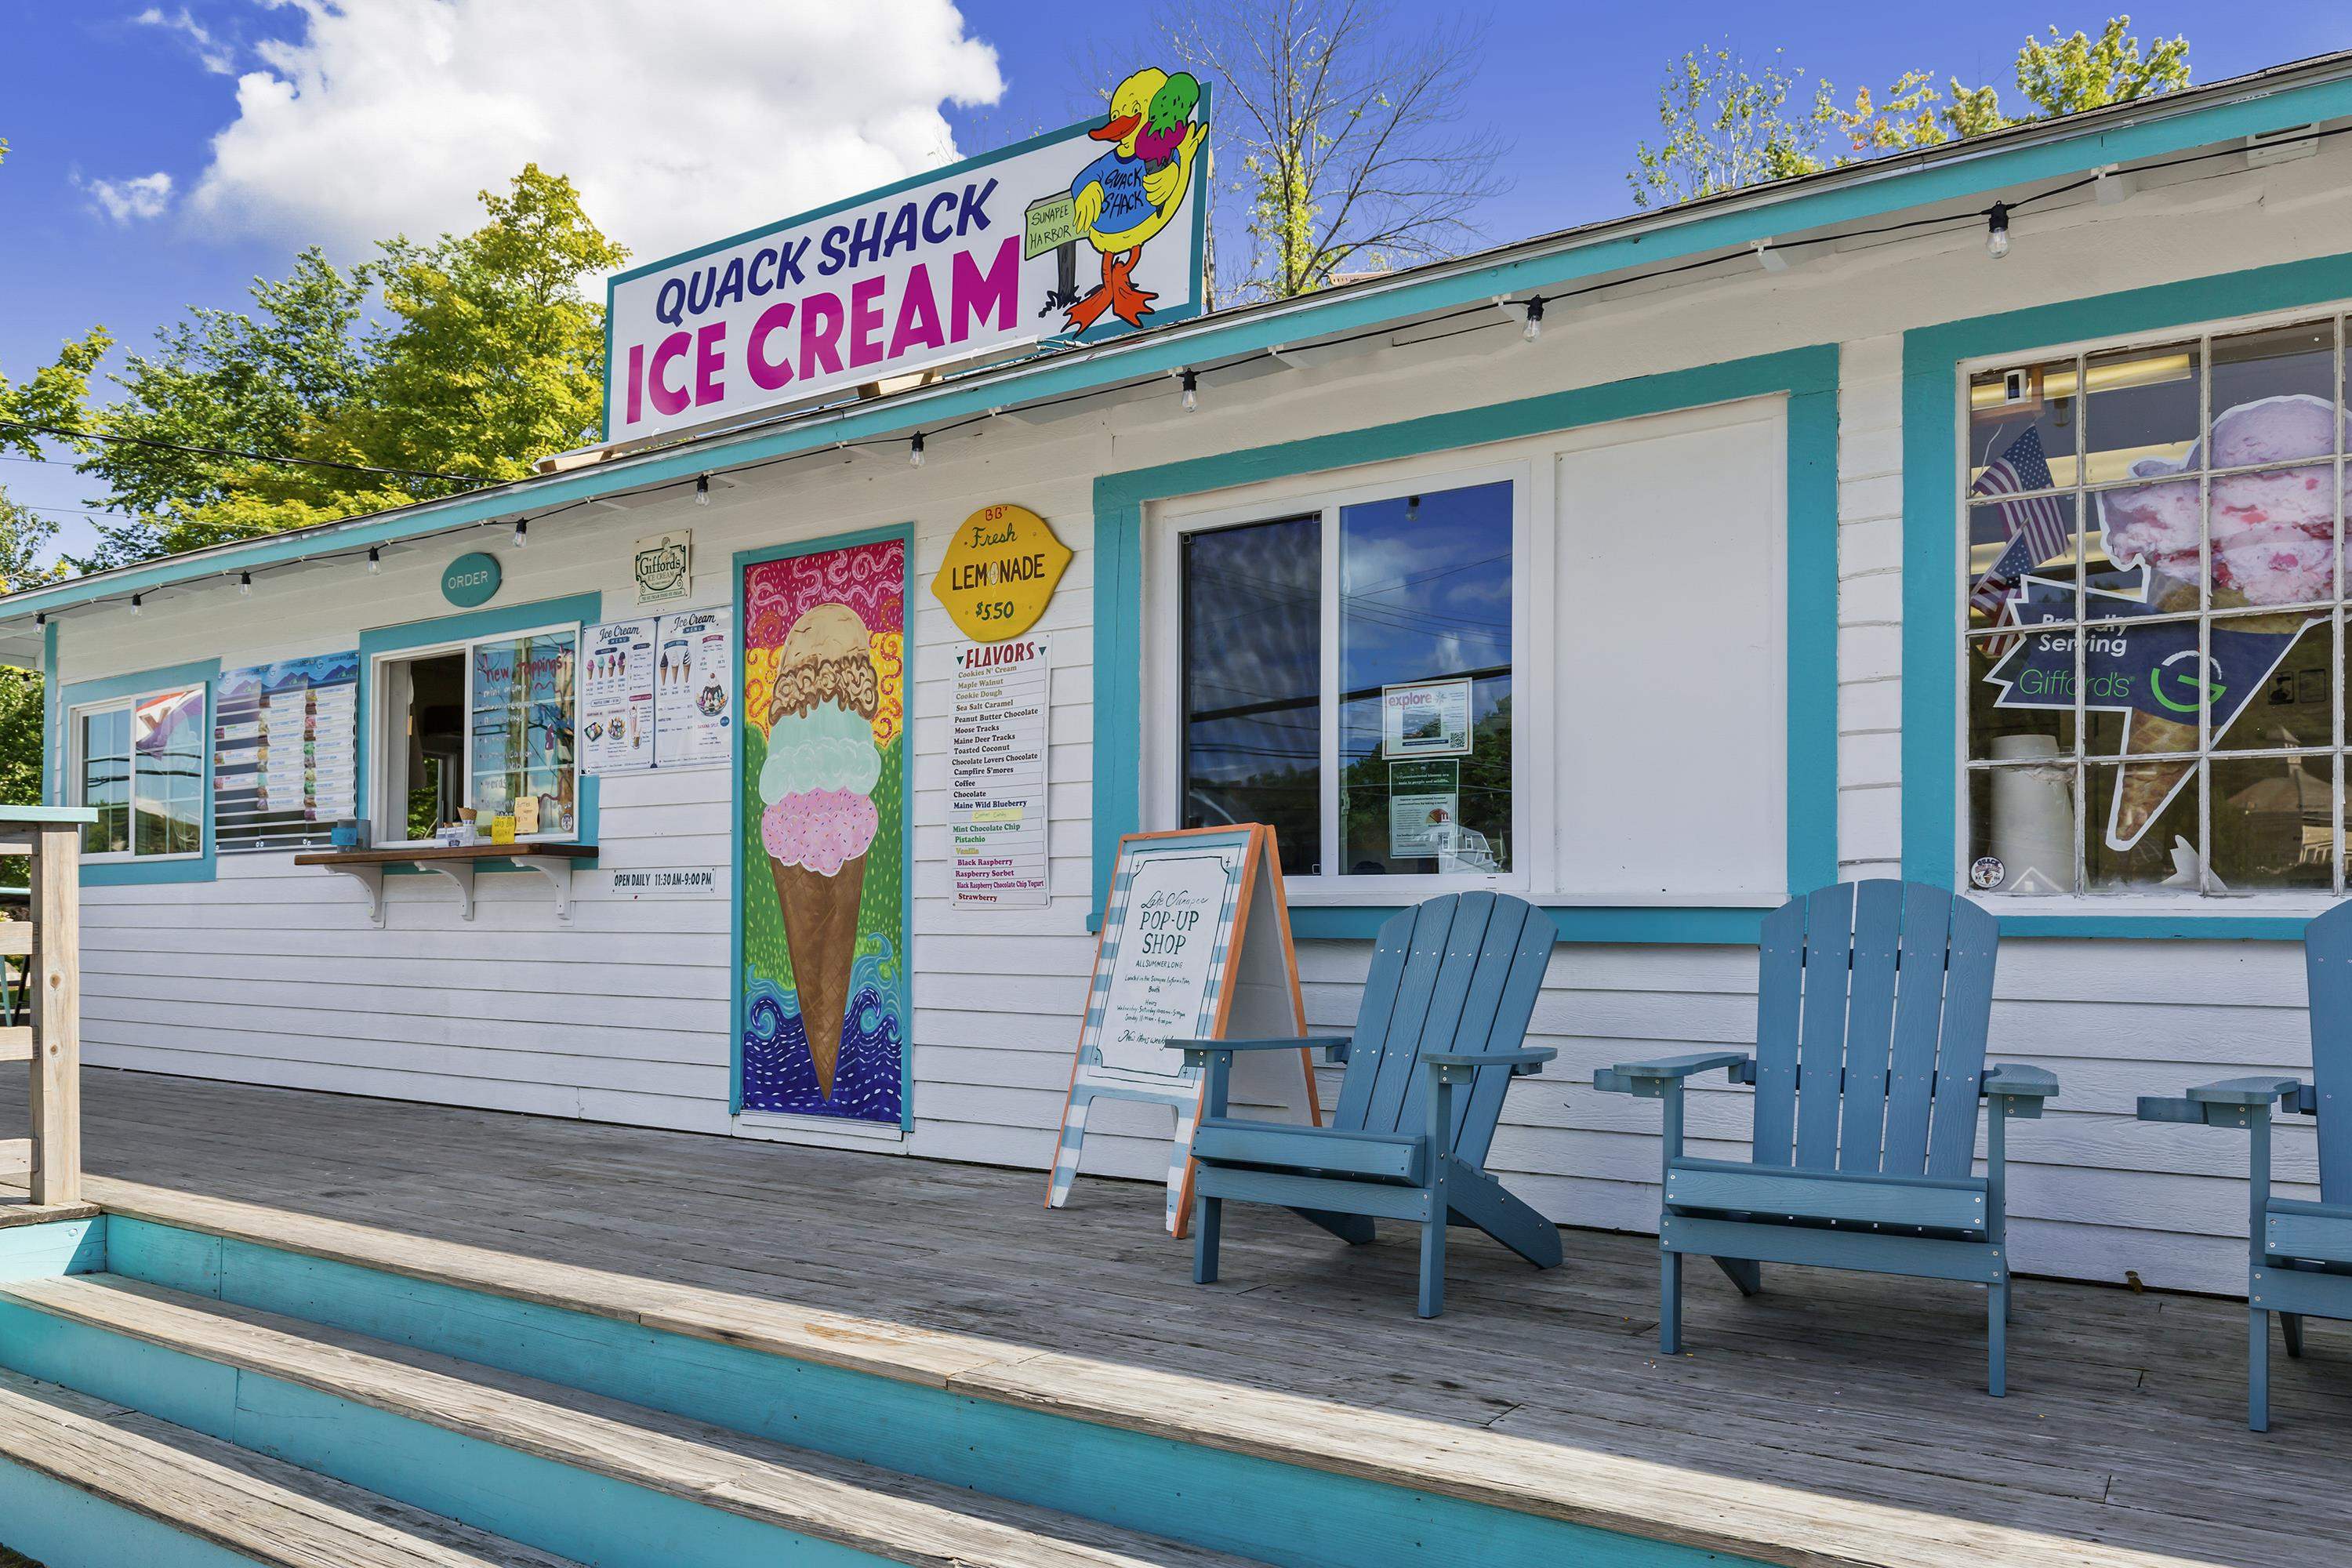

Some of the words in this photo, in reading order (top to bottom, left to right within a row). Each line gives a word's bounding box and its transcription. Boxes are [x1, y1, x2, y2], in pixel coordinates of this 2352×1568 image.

[1105, 165, 1143, 190] QUACK
[1101, 191, 1144, 220] SHACK
[1031, 205, 1069, 226] SUNAPEE
[1030, 225, 1071, 249] HARBOR
[655, 234, 812, 328] QUACK
[817, 177, 999, 277] SHACK
[626, 321, 727, 425] ICE
[746, 234, 1020, 390] CREAM
[971, 522, 1018, 549] Fresh
[640, 550, 681, 575] Gifford's
[448, 570, 489, 590] ORDER
[952, 554, 1045, 590] LEMONADE
[975, 601, 1014, 621] $5.50
[673, 615, 688, 631] Ice
[689, 613, 717, 626] Cream
[599, 627, 612, 642] Ice
[614, 625, 641, 637] Cream
[965, 641, 1035, 669] FLAVORS
[958, 670, 985, 679] Cookies
[995, 666, 1018, 674] Cream
[958, 681, 978, 690] Maple
[956, 691, 979, 700] Cookie
[980, 689, 1003, 699] Dough
[1388, 692, 1432, 710] explore
[969, 702, 982, 710] Salt
[985, 699, 1014, 709] Caramel
[954, 714, 978, 723] Peanut
[980, 712, 1002, 720] Butter
[1004, 707, 1039, 719] Chocolate
[977, 724, 1000, 733] Tracks
[992, 733, 1016, 742] Tracks
[953, 746, 980, 755] Toasted
[982, 744, 1010, 753] Coconut
[952, 756, 982, 765] Chocolate
[984, 754, 1005, 764] Lovers
[1006, 752, 1038, 762] Chocolate
[954, 768, 985, 776] Campfire
[993, 799, 1027, 808] Blueberry
[970, 824, 1003, 833] Chocolate
[1004, 822, 1021, 831] Chip
[978, 858, 1013, 867] Raspberry
[614, 874, 630, 887] OPEN
[632, 873, 651, 886] DAILY
[655, 873, 671, 886] 11:30
[701, 873, 712, 885] PM
[1016, 880, 1027, 888] Chip
[1028, 880, 1044, 888] Yogurt
[958, 892, 998, 902] Strawberry
[1141, 890, 1163, 909] Lake
[1139, 910, 1200, 931] POP-UP
[1142, 933, 1186, 955] SHOP
[1135, 959, 1145, 967] ALL
[1145, 959, 1167, 968] SUMMER
